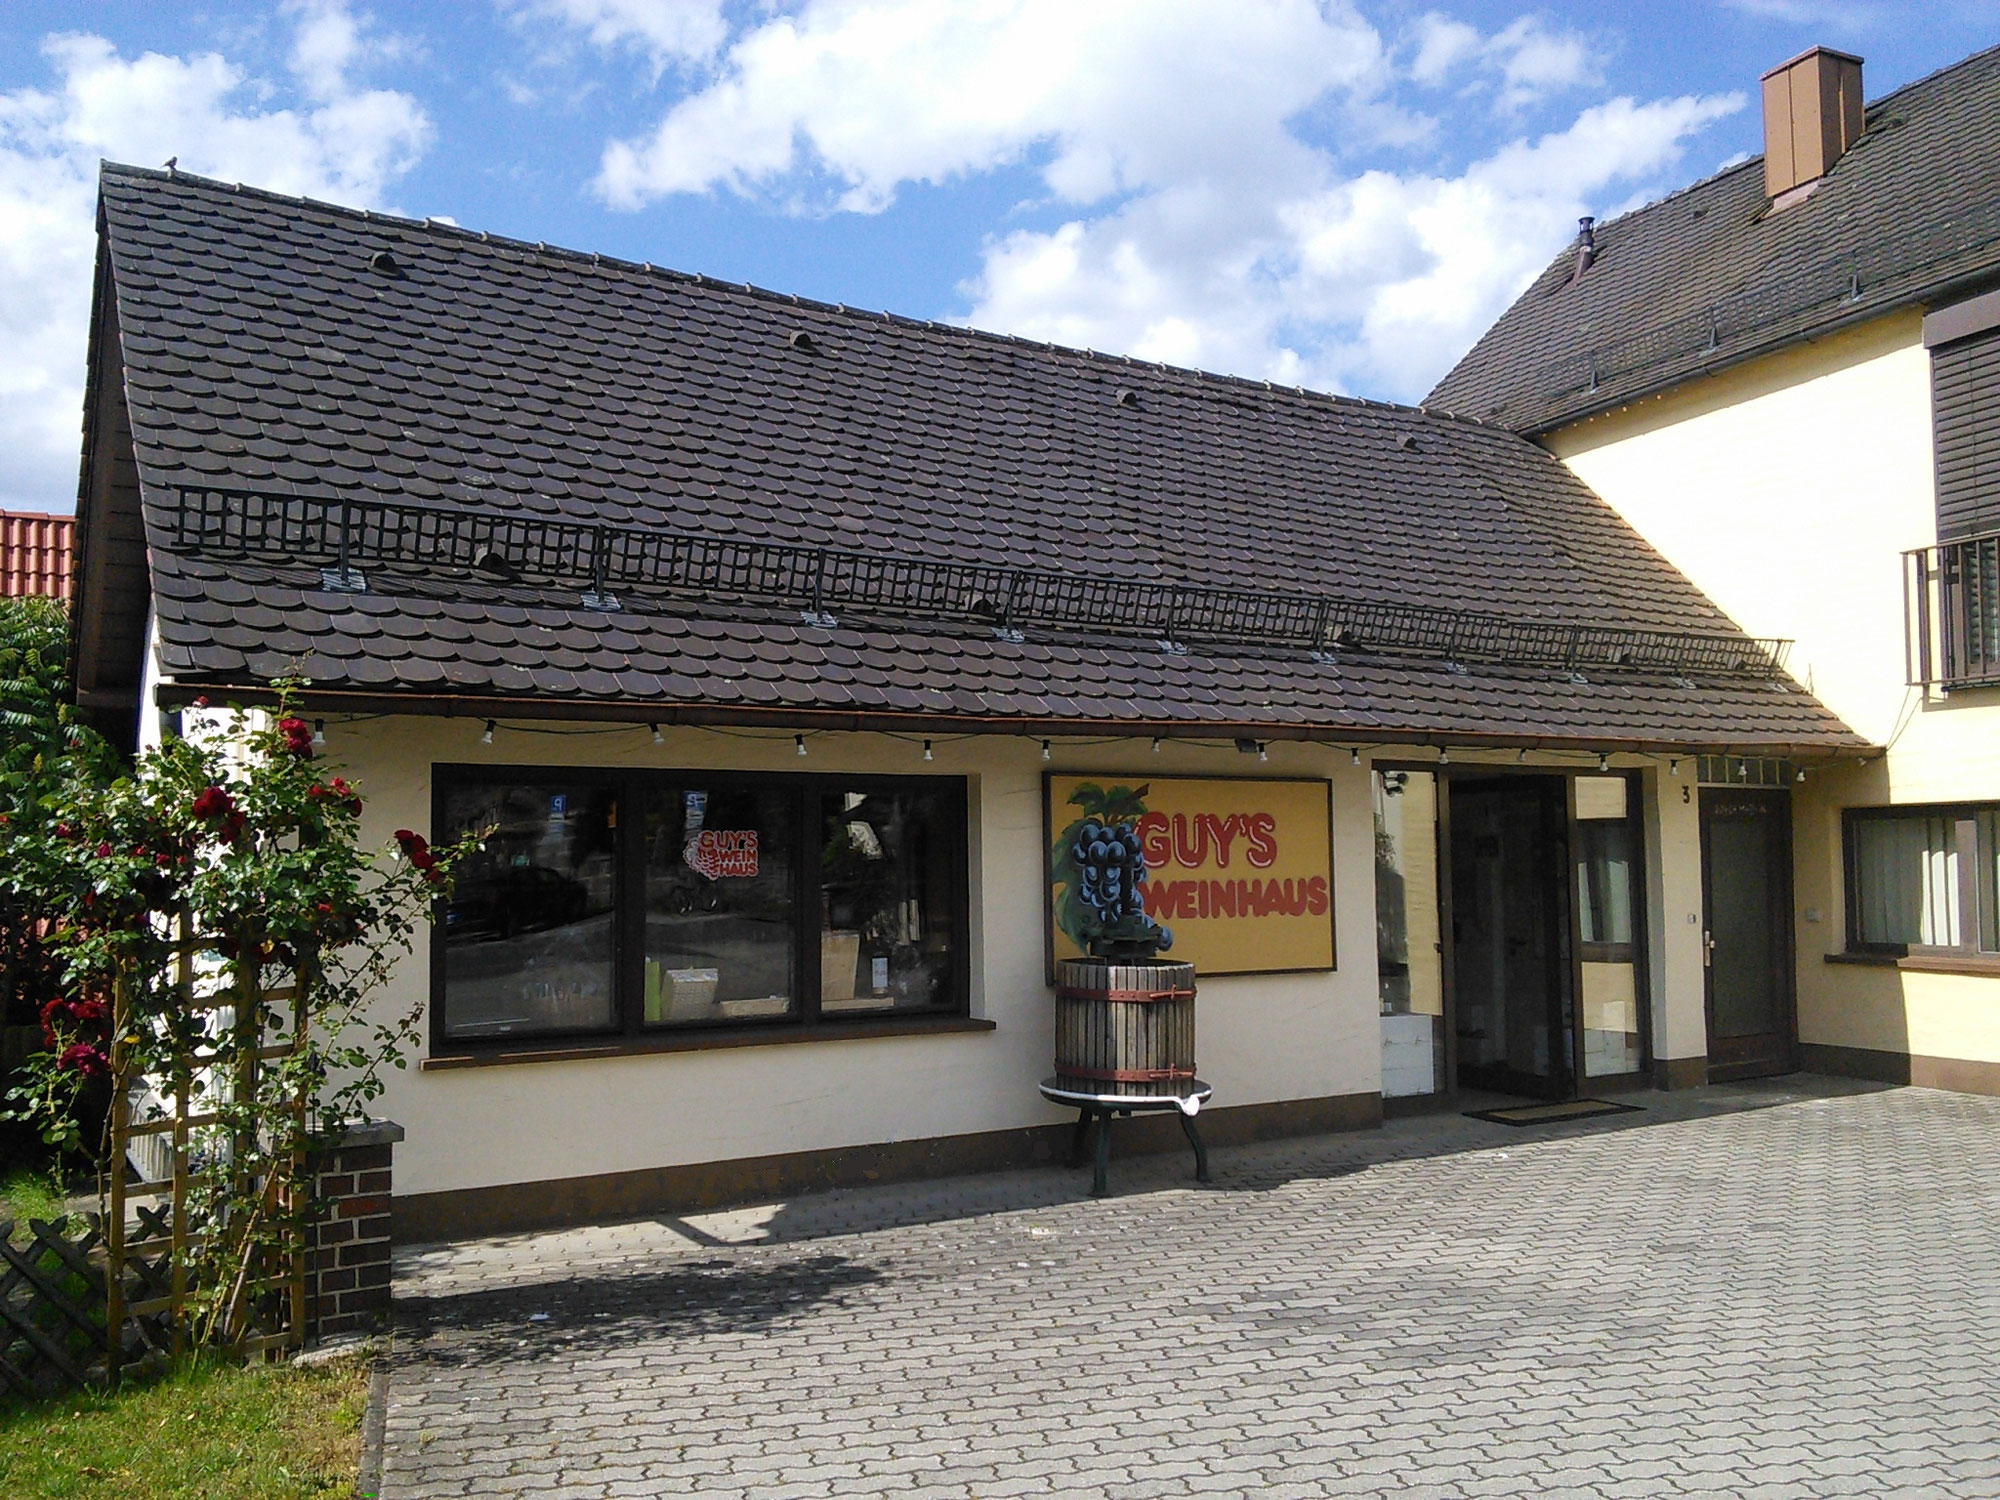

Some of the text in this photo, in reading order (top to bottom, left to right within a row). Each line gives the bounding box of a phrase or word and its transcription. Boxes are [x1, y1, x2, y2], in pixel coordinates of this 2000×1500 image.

[1681, 785, 1691, 804] 3
[700, 830, 758, 849] GUY'S
[1134, 811, 1278, 869] GUY'S
[720, 849, 757, 863] WEIN
[720, 863, 758, 876] HAUS
[1136, 876, 1328, 920] WEINHAUS
